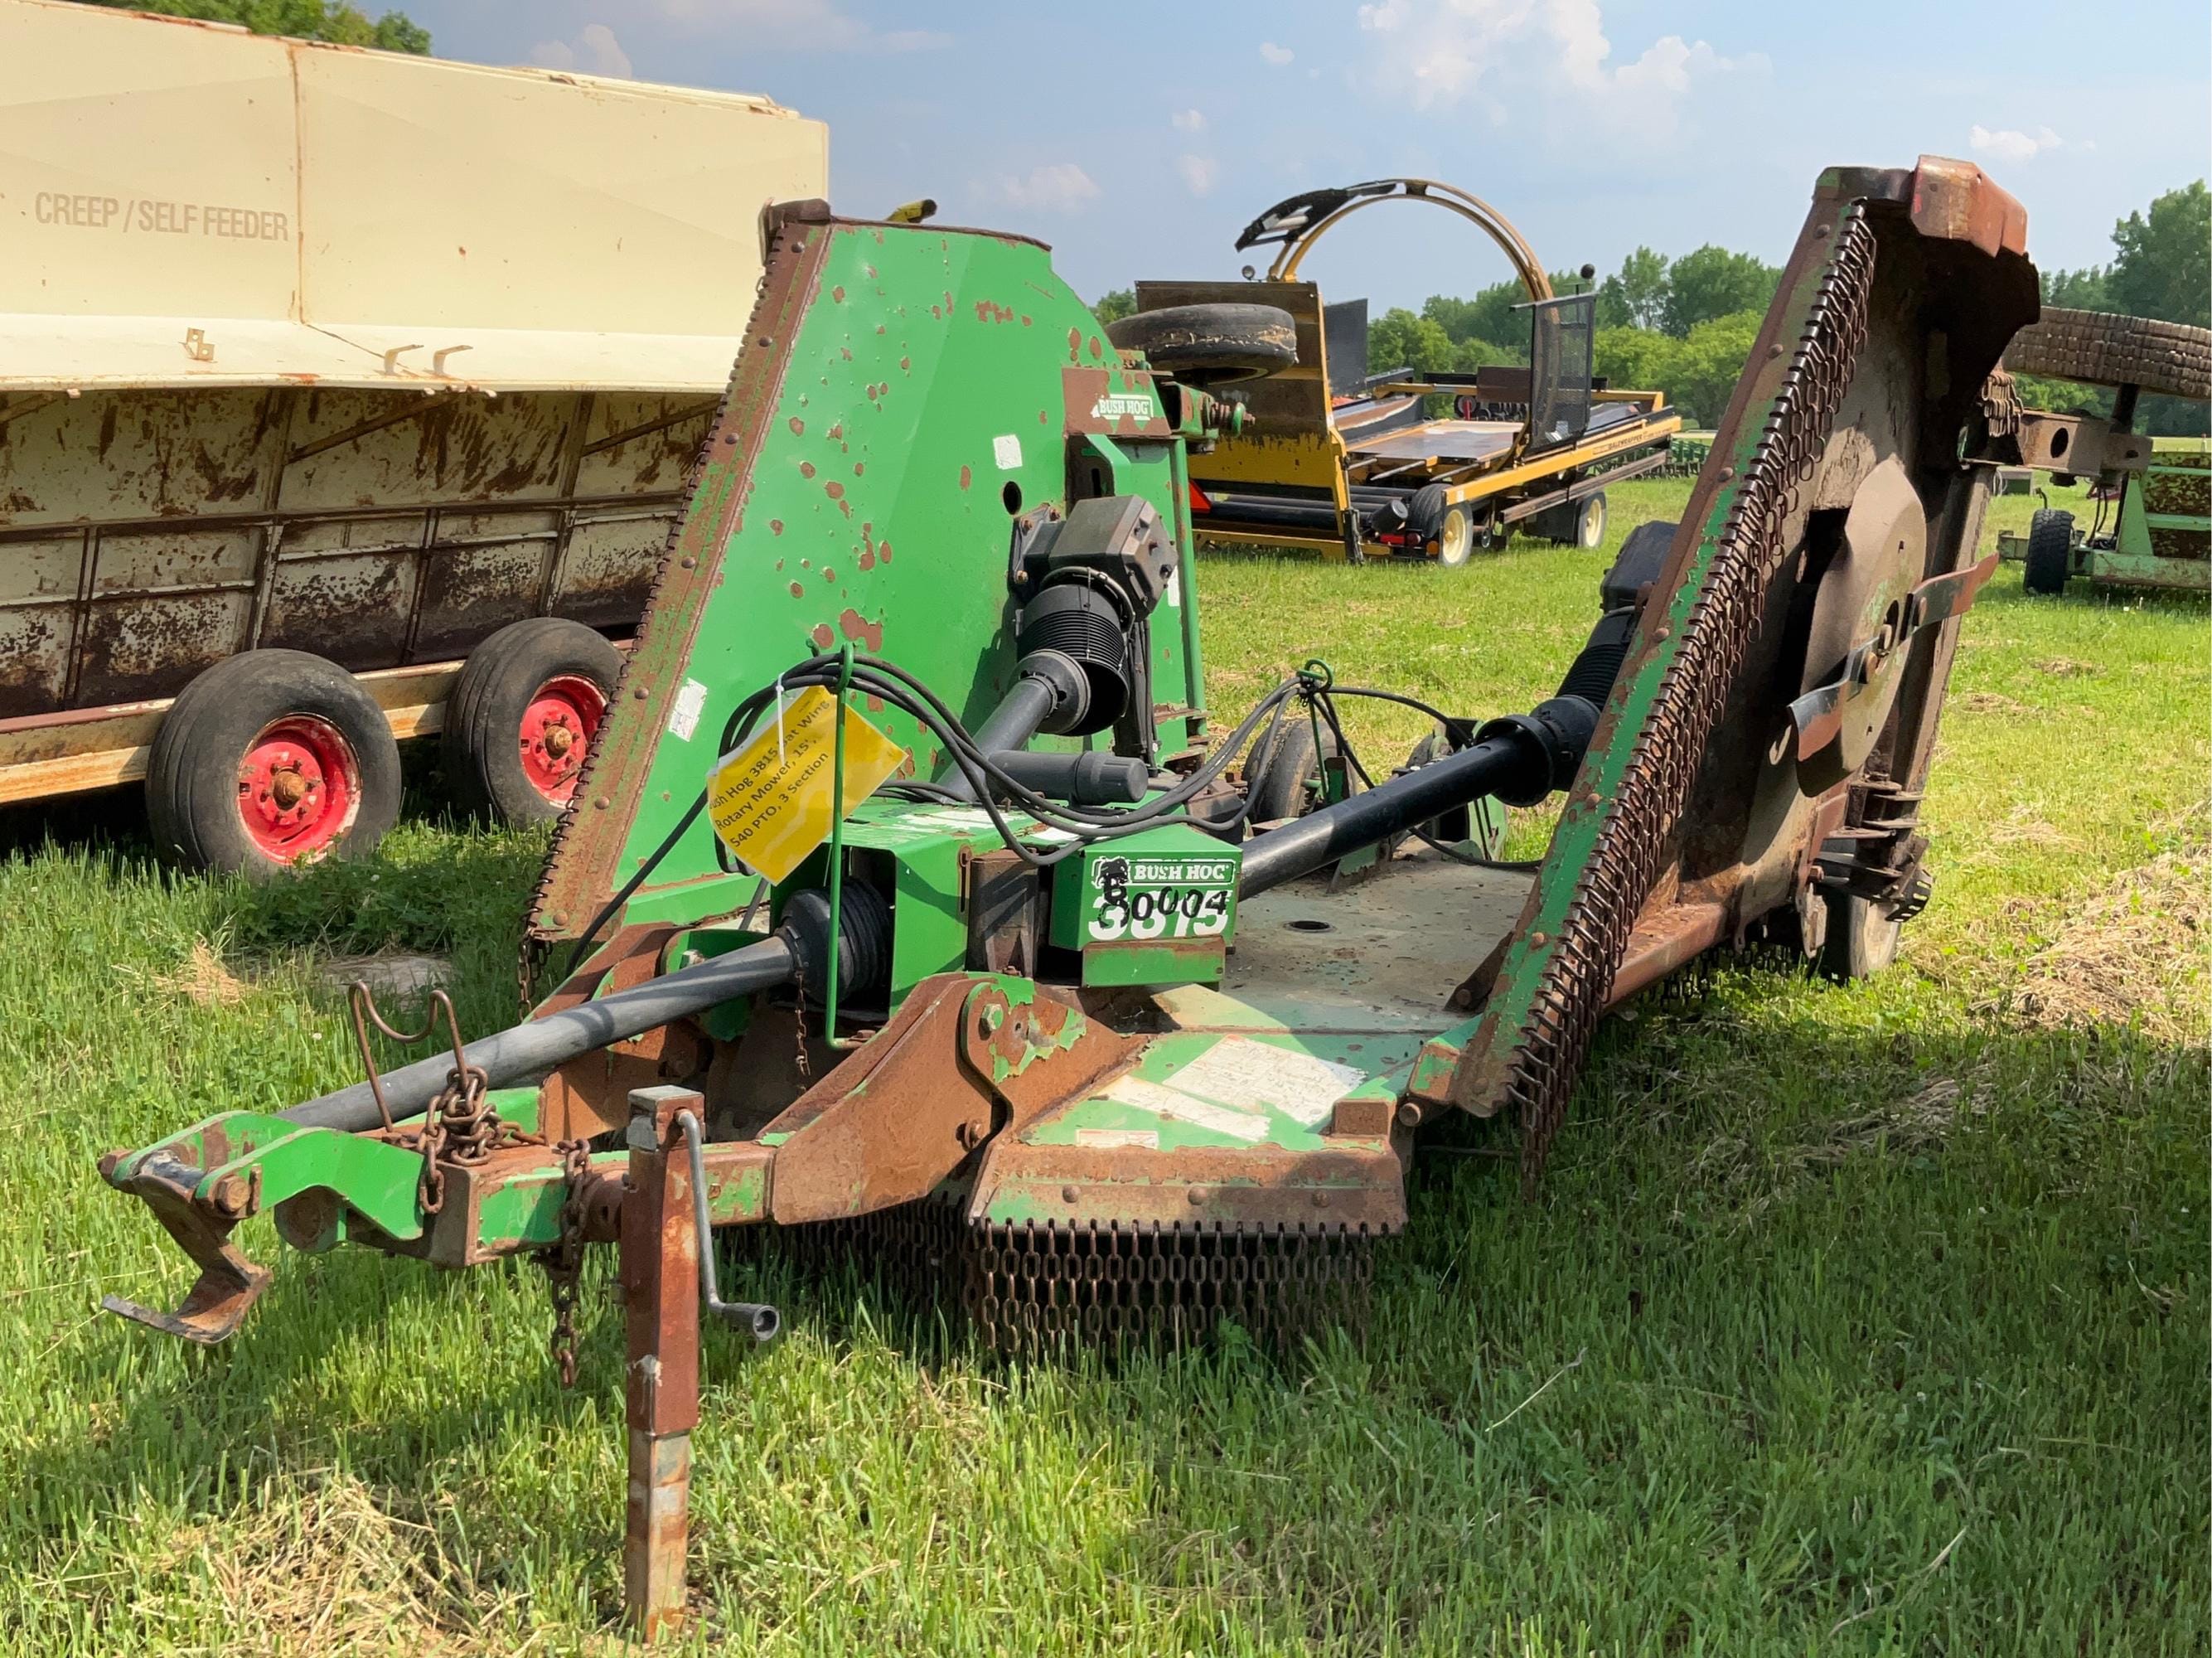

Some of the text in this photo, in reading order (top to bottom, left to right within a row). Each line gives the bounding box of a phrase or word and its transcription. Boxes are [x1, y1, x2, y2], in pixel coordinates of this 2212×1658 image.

[35, 191, 119, 229] CREEP
[138, 200, 197, 234] SELF
[203, 206, 288, 241] FEEDER
[1098, 399, 1149, 414] BUSH HOG
[709, 794, 728, 810] ush
[726, 778, 753, 798] Hog
[750, 748, 777, 777] 3815
[797, 701, 830, 729] Wing
[715, 739, 816, 830] Rotary Mower, 15',
[729, 753, 828, 847] 540 PTO, 3 Section
[1134, 865, 1183, 880] BUSH
